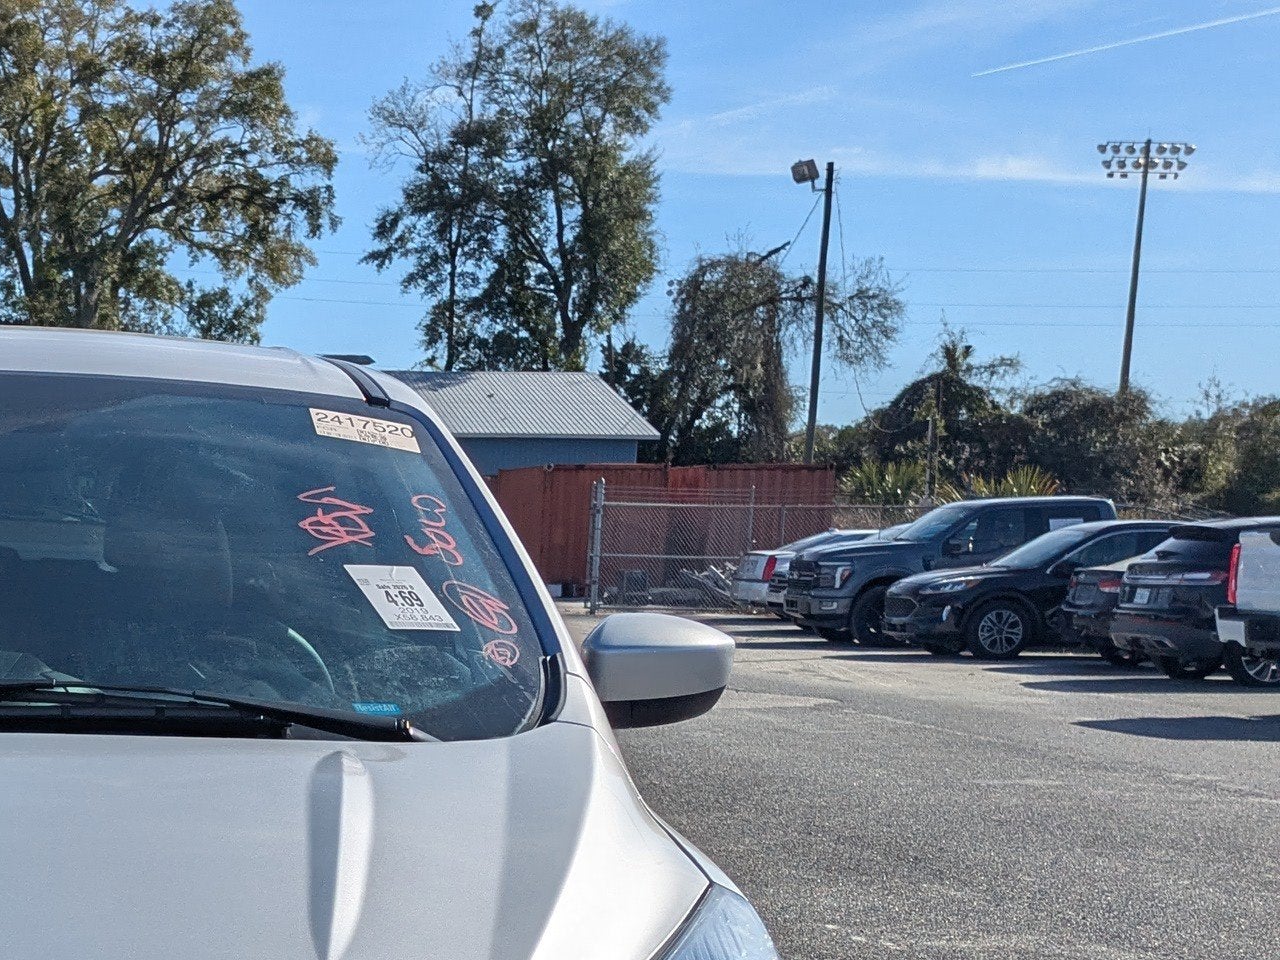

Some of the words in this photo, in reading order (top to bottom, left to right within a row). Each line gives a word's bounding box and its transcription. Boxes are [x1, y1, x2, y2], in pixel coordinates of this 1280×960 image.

[315, 412, 414, 439] 2417520
[384, 590, 425, 608] 4:69
[398, 607, 429, 615] 2019
